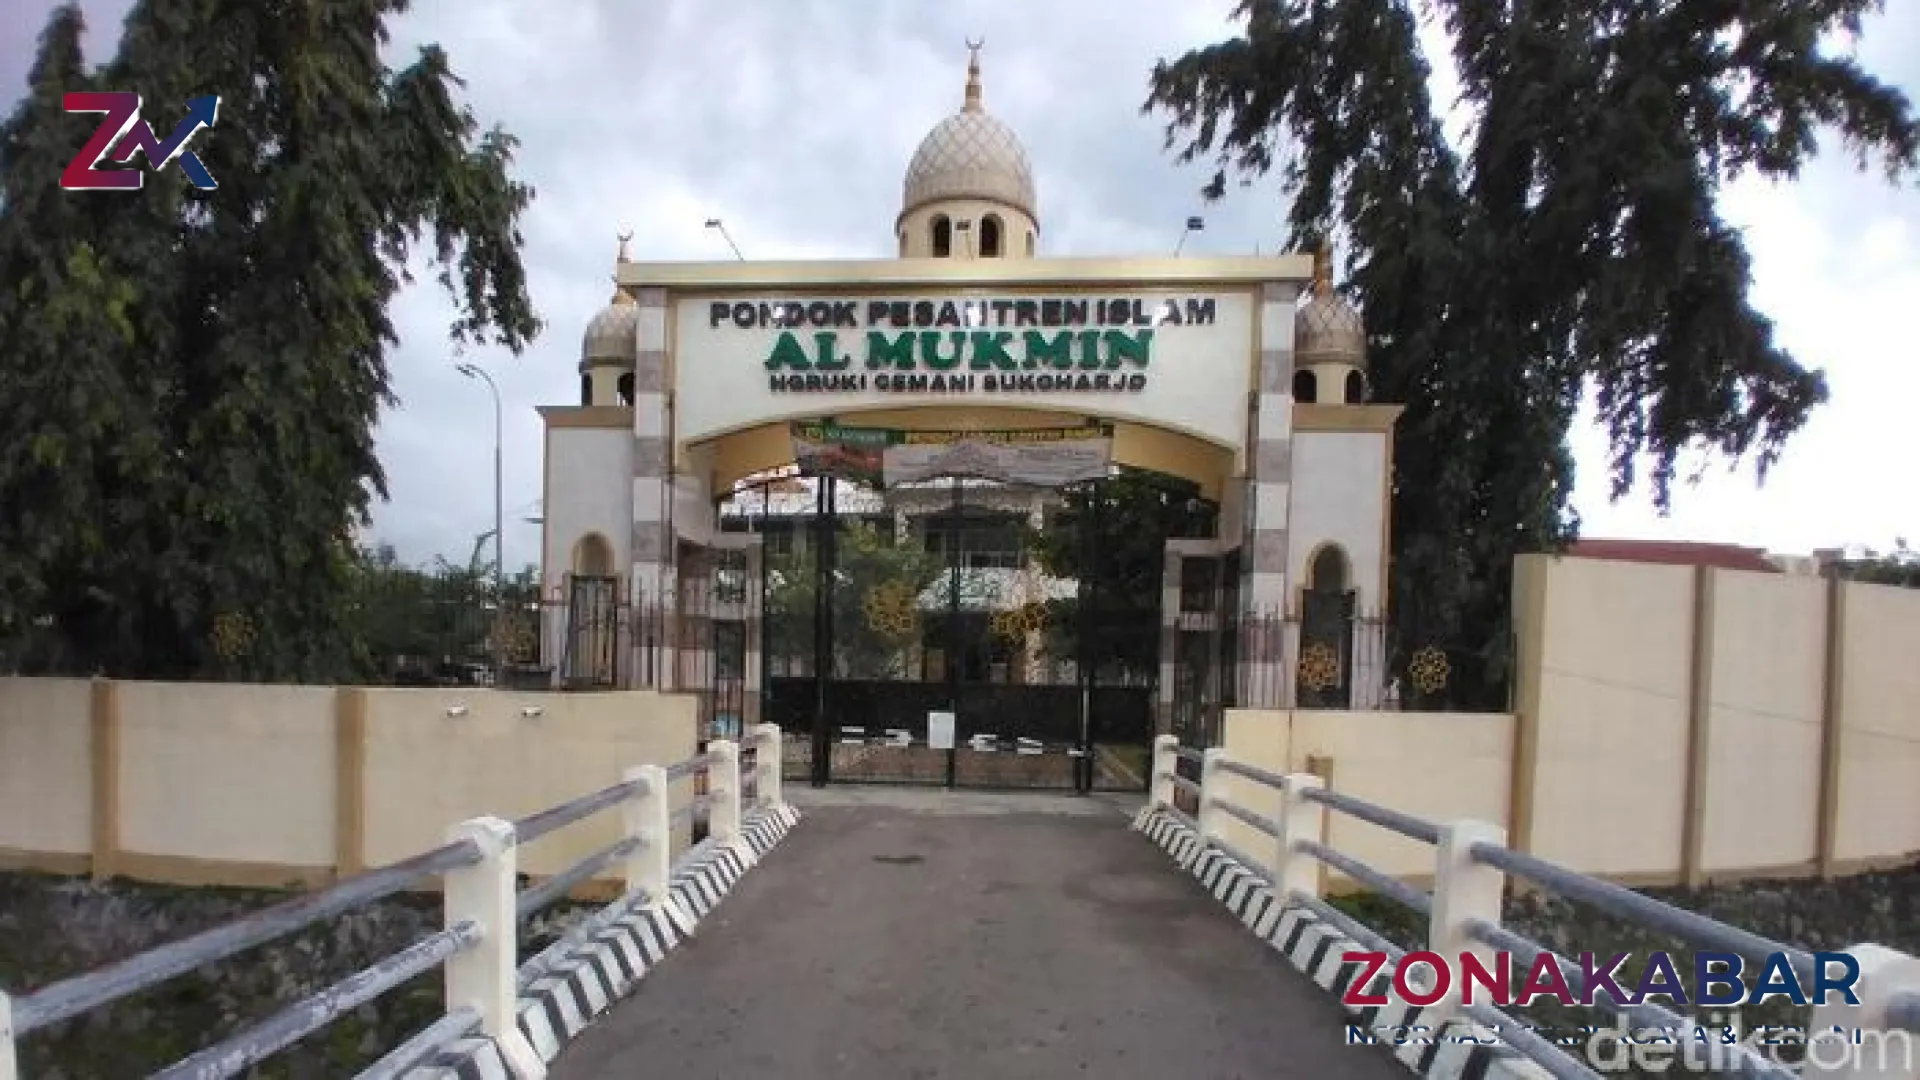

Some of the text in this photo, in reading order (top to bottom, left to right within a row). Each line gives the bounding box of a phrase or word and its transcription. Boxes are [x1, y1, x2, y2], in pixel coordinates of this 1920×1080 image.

[710, 300, 858, 328] PONDOK
[1097, 298, 1216, 327] ISLAM
[764, 328, 1154, 371] AL MUKMIN
